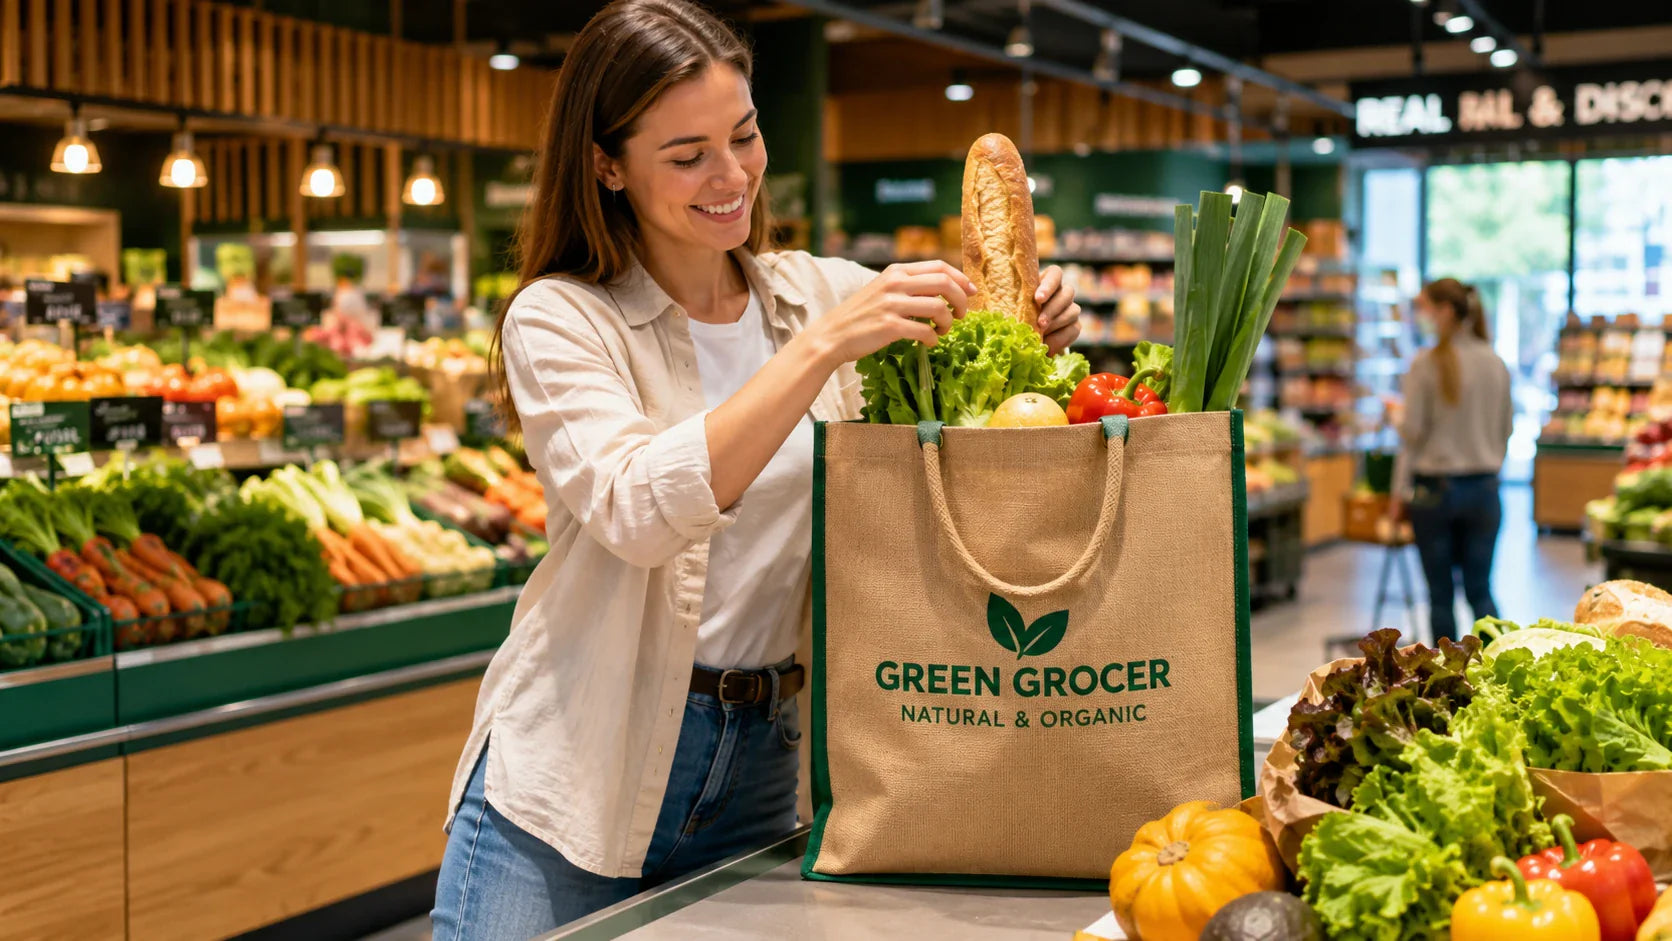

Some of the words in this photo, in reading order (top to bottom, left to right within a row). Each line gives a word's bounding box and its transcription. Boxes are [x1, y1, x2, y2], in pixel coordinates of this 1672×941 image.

[1355, 94, 1451, 137] REAL
[1528, 85, 1564, 127] &
[875, 660, 1000, 697] GREEN
[1012, 658, 1172, 698] GROCER
[901, 704, 1006, 728] NATURAL
[1014, 710, 1031, 729] &
[1040, 704, 1148, 729] ORGANIC
